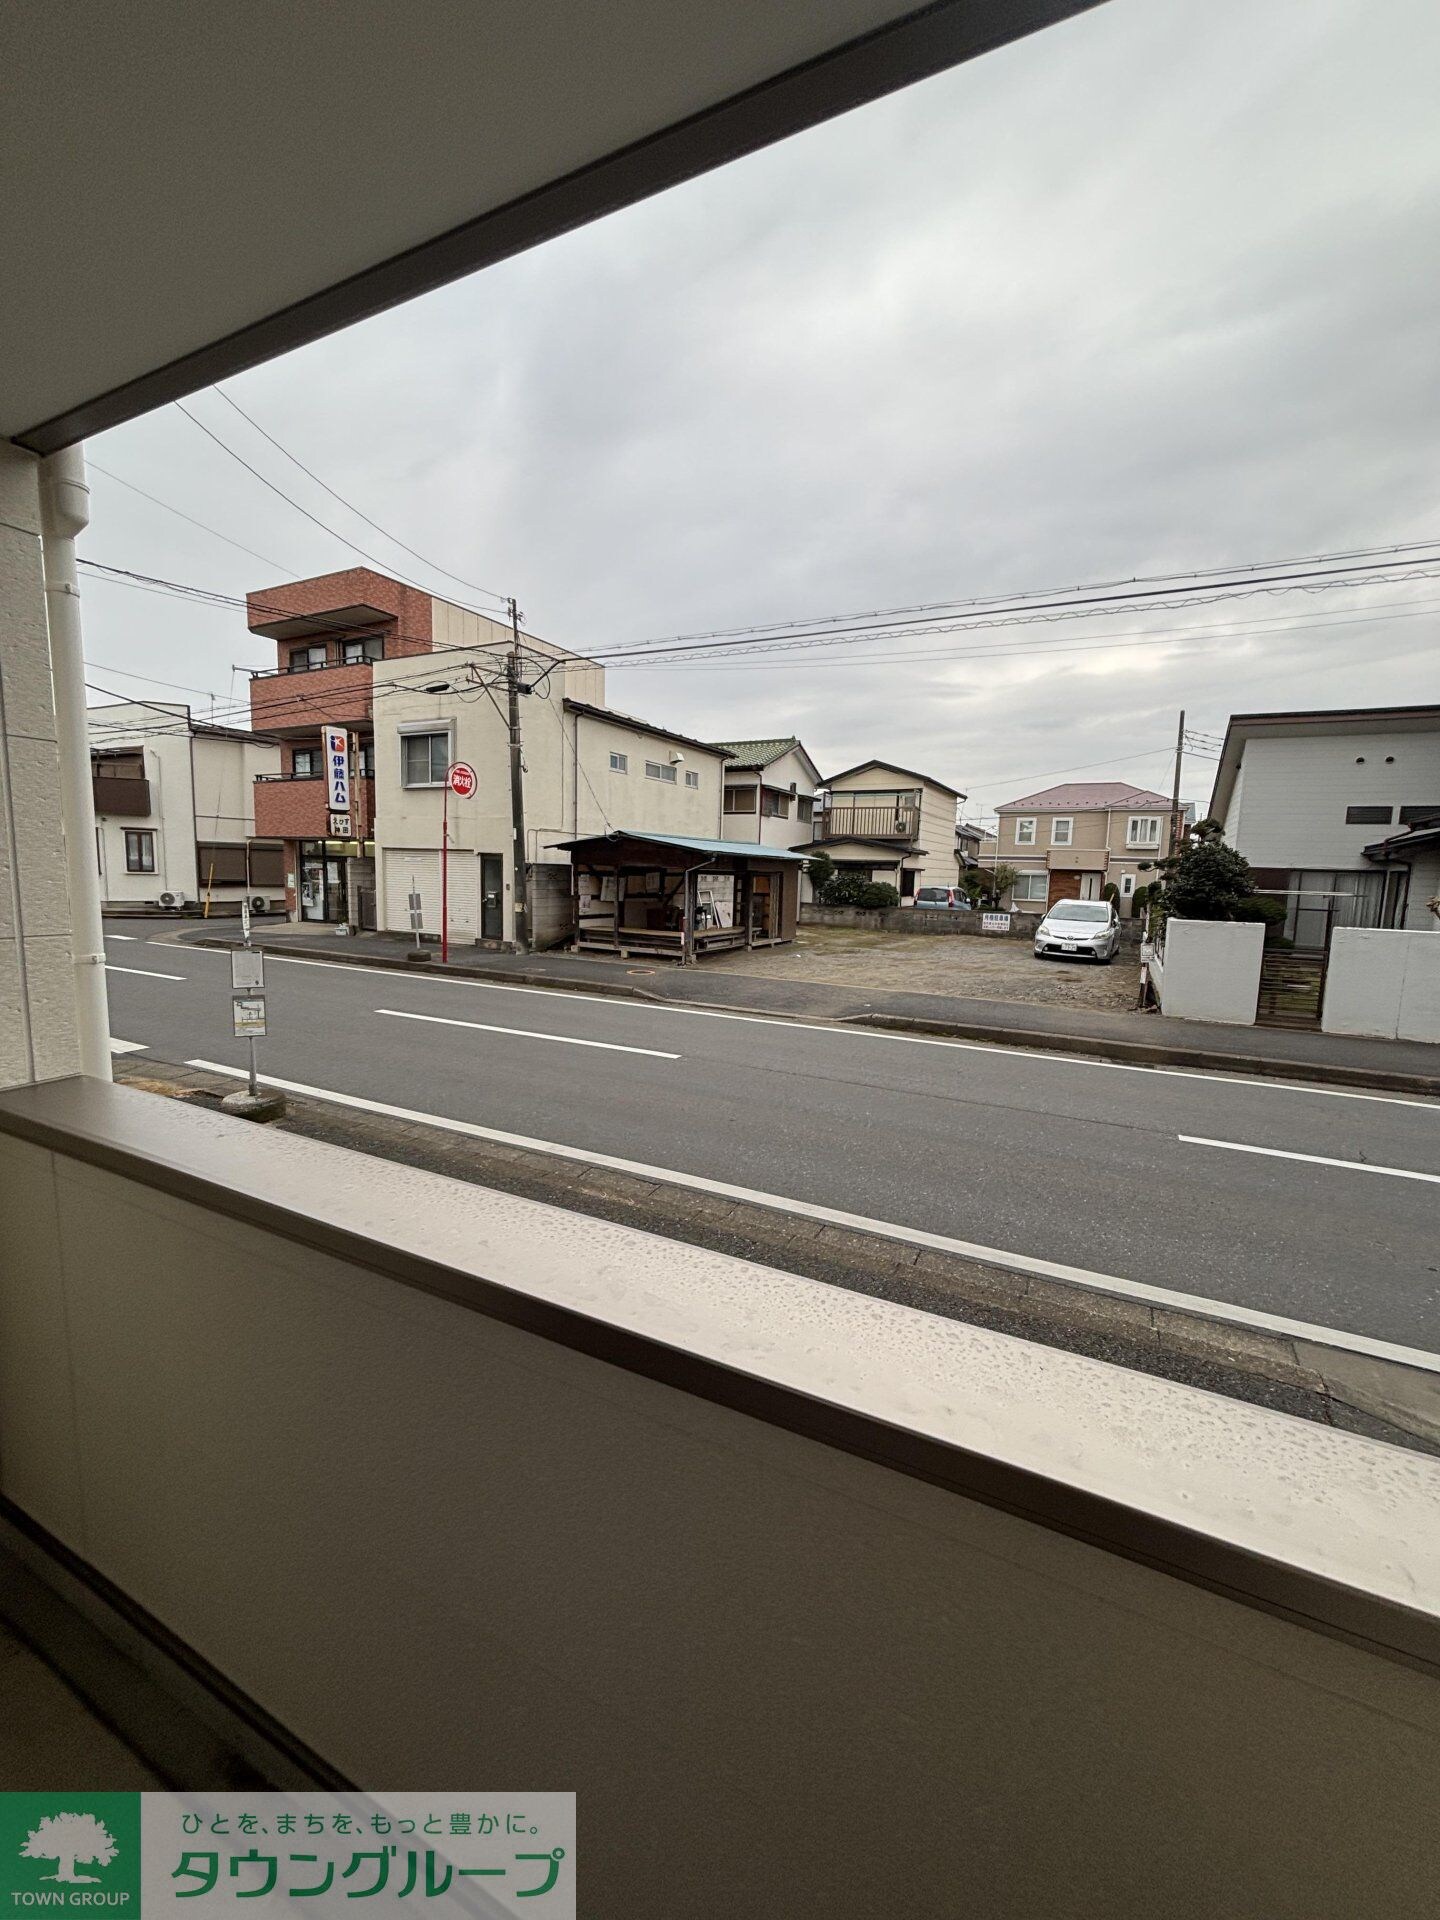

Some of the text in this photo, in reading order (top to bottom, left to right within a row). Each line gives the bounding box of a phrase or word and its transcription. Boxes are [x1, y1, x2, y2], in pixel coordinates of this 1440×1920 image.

[333, 756, 346, 803] 伊藤ハム
[453, 775, 472, 788] 消火栓
